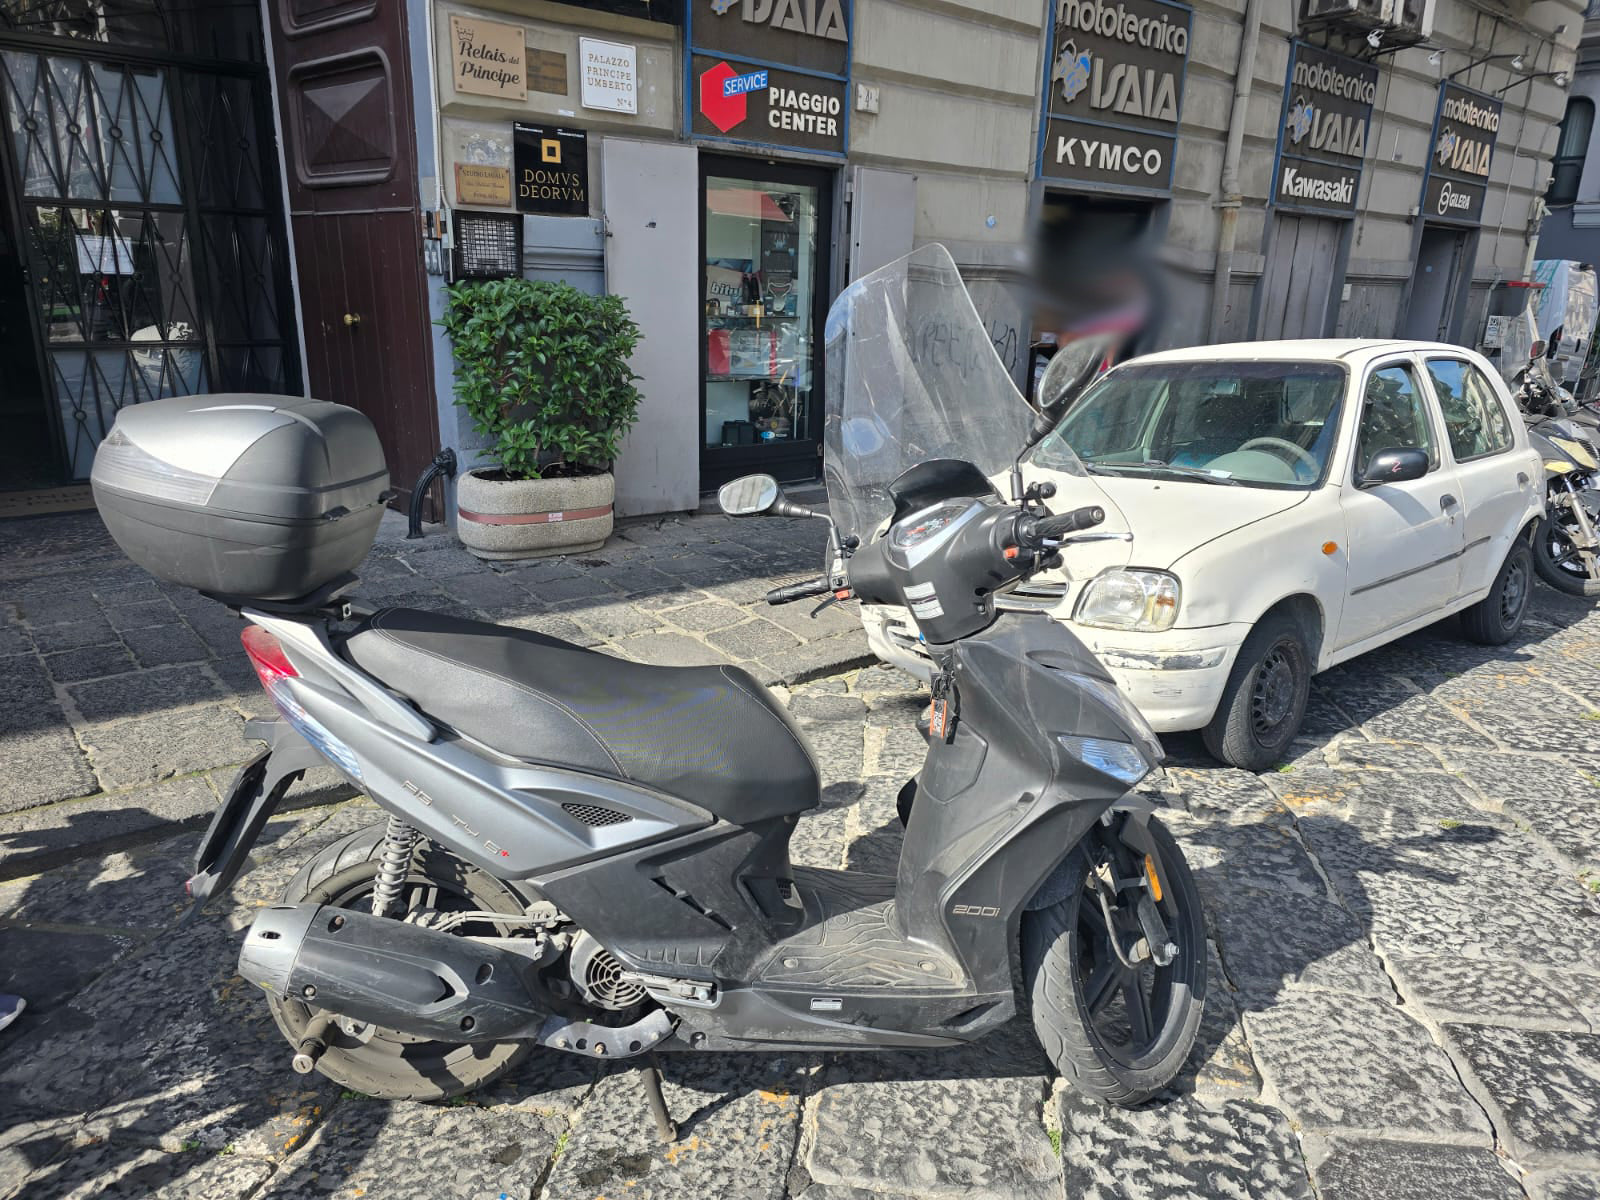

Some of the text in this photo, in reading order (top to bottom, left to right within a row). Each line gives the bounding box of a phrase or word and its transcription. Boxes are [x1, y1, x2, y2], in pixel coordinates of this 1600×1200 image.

[1056, 0, 1188, 55] mototecnica
[459, 41, 520, 65] Relais del
[588, 53, 630, 68] PALAZZO
[460, 61, 521, 88] Principe
[587, 66, 631, 81] PRINCIPE
[587, 76, 633, 92] UMBERTO
[724, 73, 768, 96] SERVICE
[1294, 61, 1376, 105] mototecnica
[768, 86, 841, 116] PIAGGIO
[1090, 57, 1178, 122] ISAIA
[768, 110, 838, 137] CENTER
[1443, 97, 1499, 133] mototecnica
[1308, 108, 1366, 158] ISAIA
[1055, 136, 1162, 175] KYMCO
[1450, 135, 1491, 177] ISAIA
[524, 169, 580, 187] DOMVS
[1281, 167, 1355, 203] Kawasaki
[519, 184, 585, 202] DEORVM
[1449, 193, 1471, 210] GILERA
[952, 904, 1001, 918] 200i
